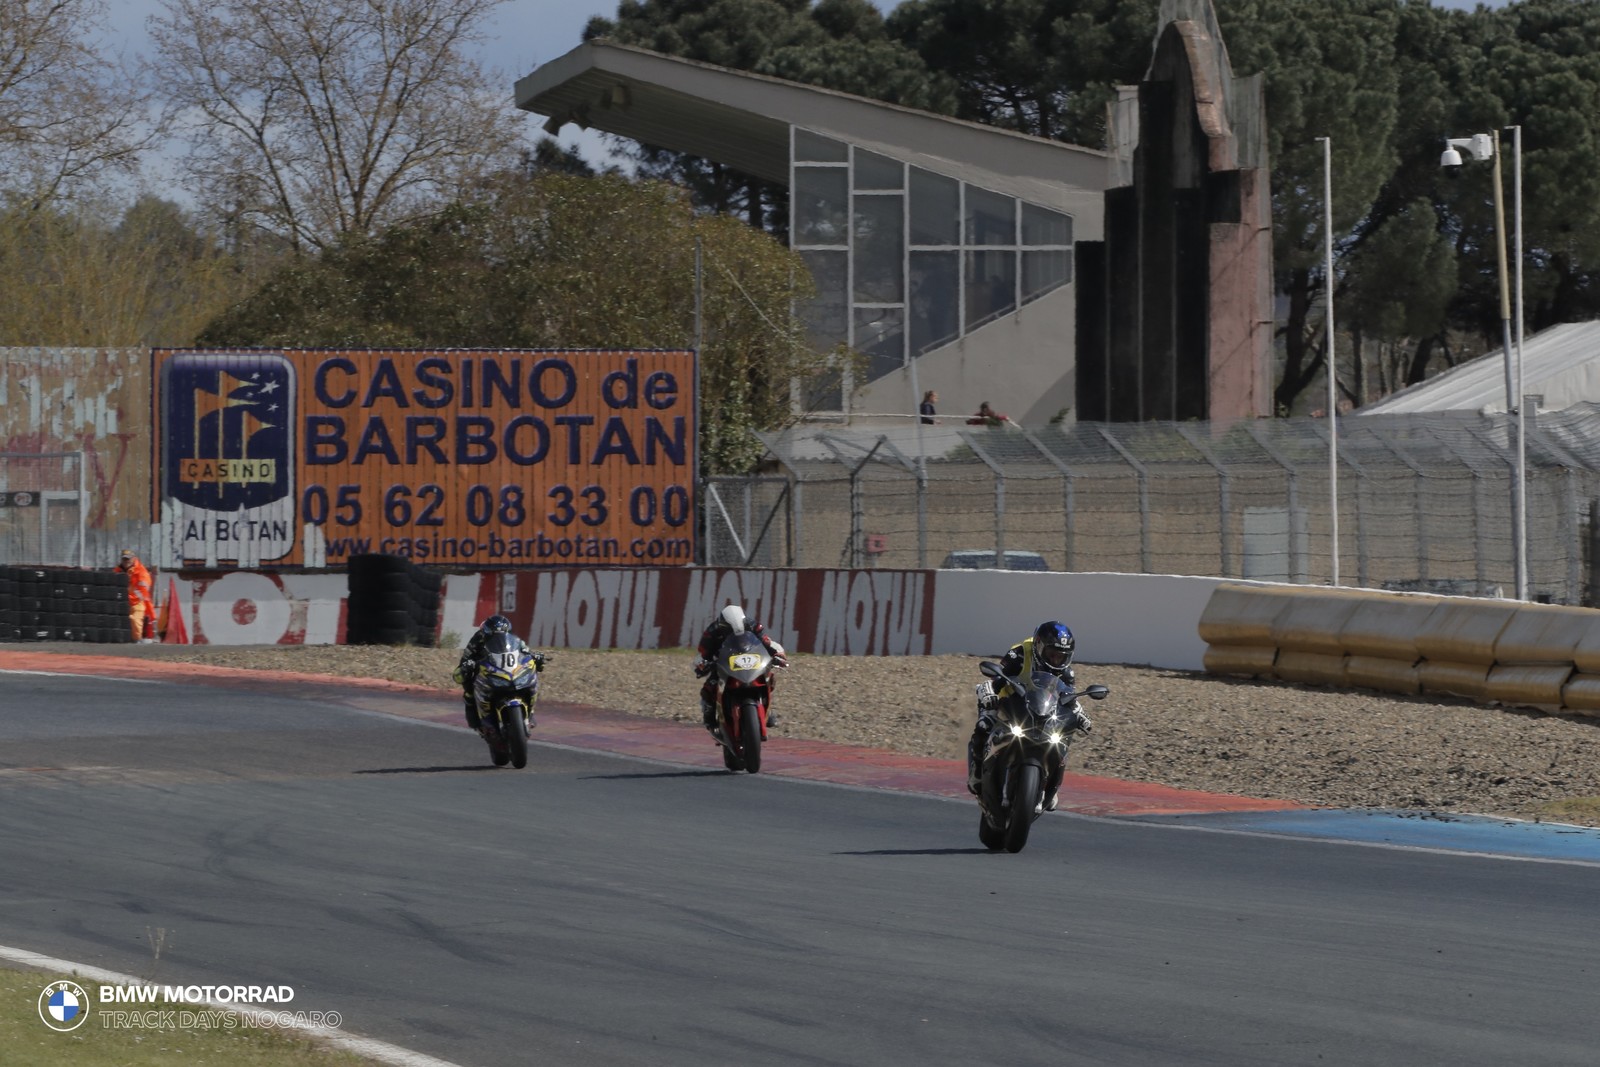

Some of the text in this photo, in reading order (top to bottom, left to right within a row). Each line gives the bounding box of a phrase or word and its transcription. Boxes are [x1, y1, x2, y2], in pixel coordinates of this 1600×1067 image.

[314, 358, 679, 410] CASINO de
[306, 415, 686, 465] BARBOTAN
[187, 462, 271, 478] CASINO
[302, 484, 690, 527] 05 62 08 33 00
[301, 531, 691, 558] wwcasino-barbotan.com
[529, 570, 661, 649] MOTUL
[813, 570, 926, 656] MOTUL
[501, 653, 516, 669] 10
